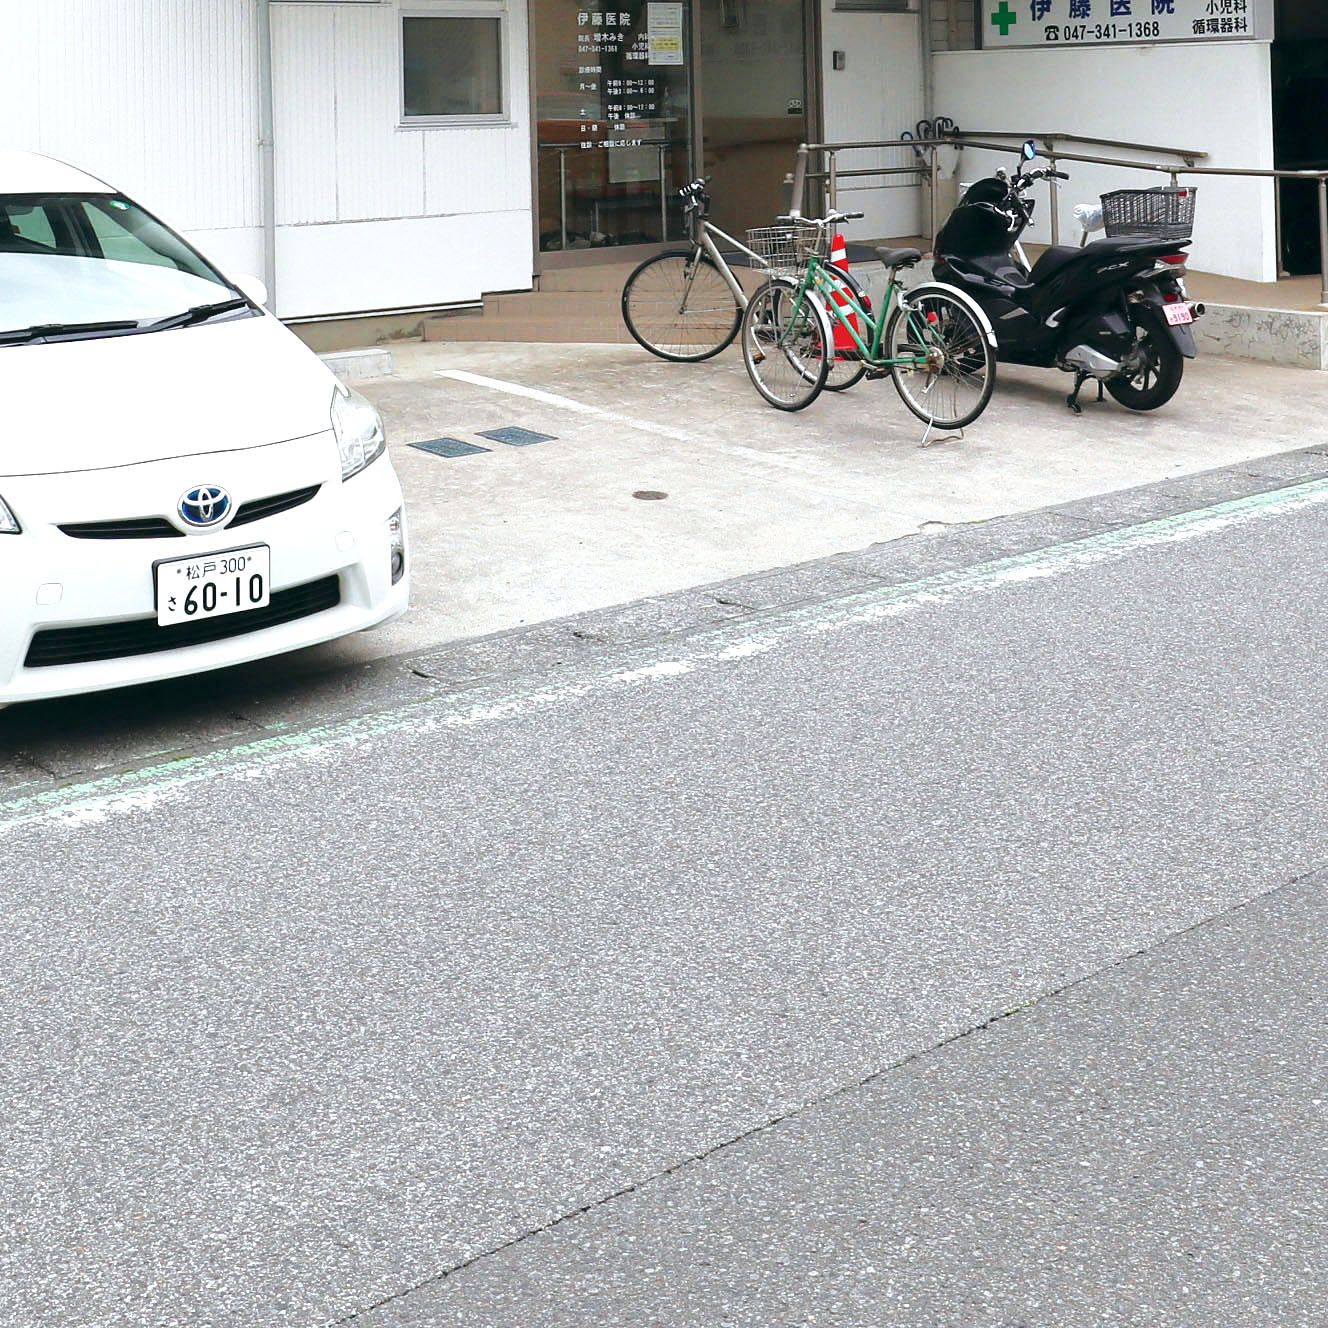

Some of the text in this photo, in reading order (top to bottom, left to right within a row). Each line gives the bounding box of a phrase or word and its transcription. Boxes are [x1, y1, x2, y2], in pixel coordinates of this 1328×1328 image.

[577, 12, 631, 26] 伊藤医院
[1192, 18, 1248, 36] 循環器科
[1064, 21, 1160, 41] 047-341-1368
